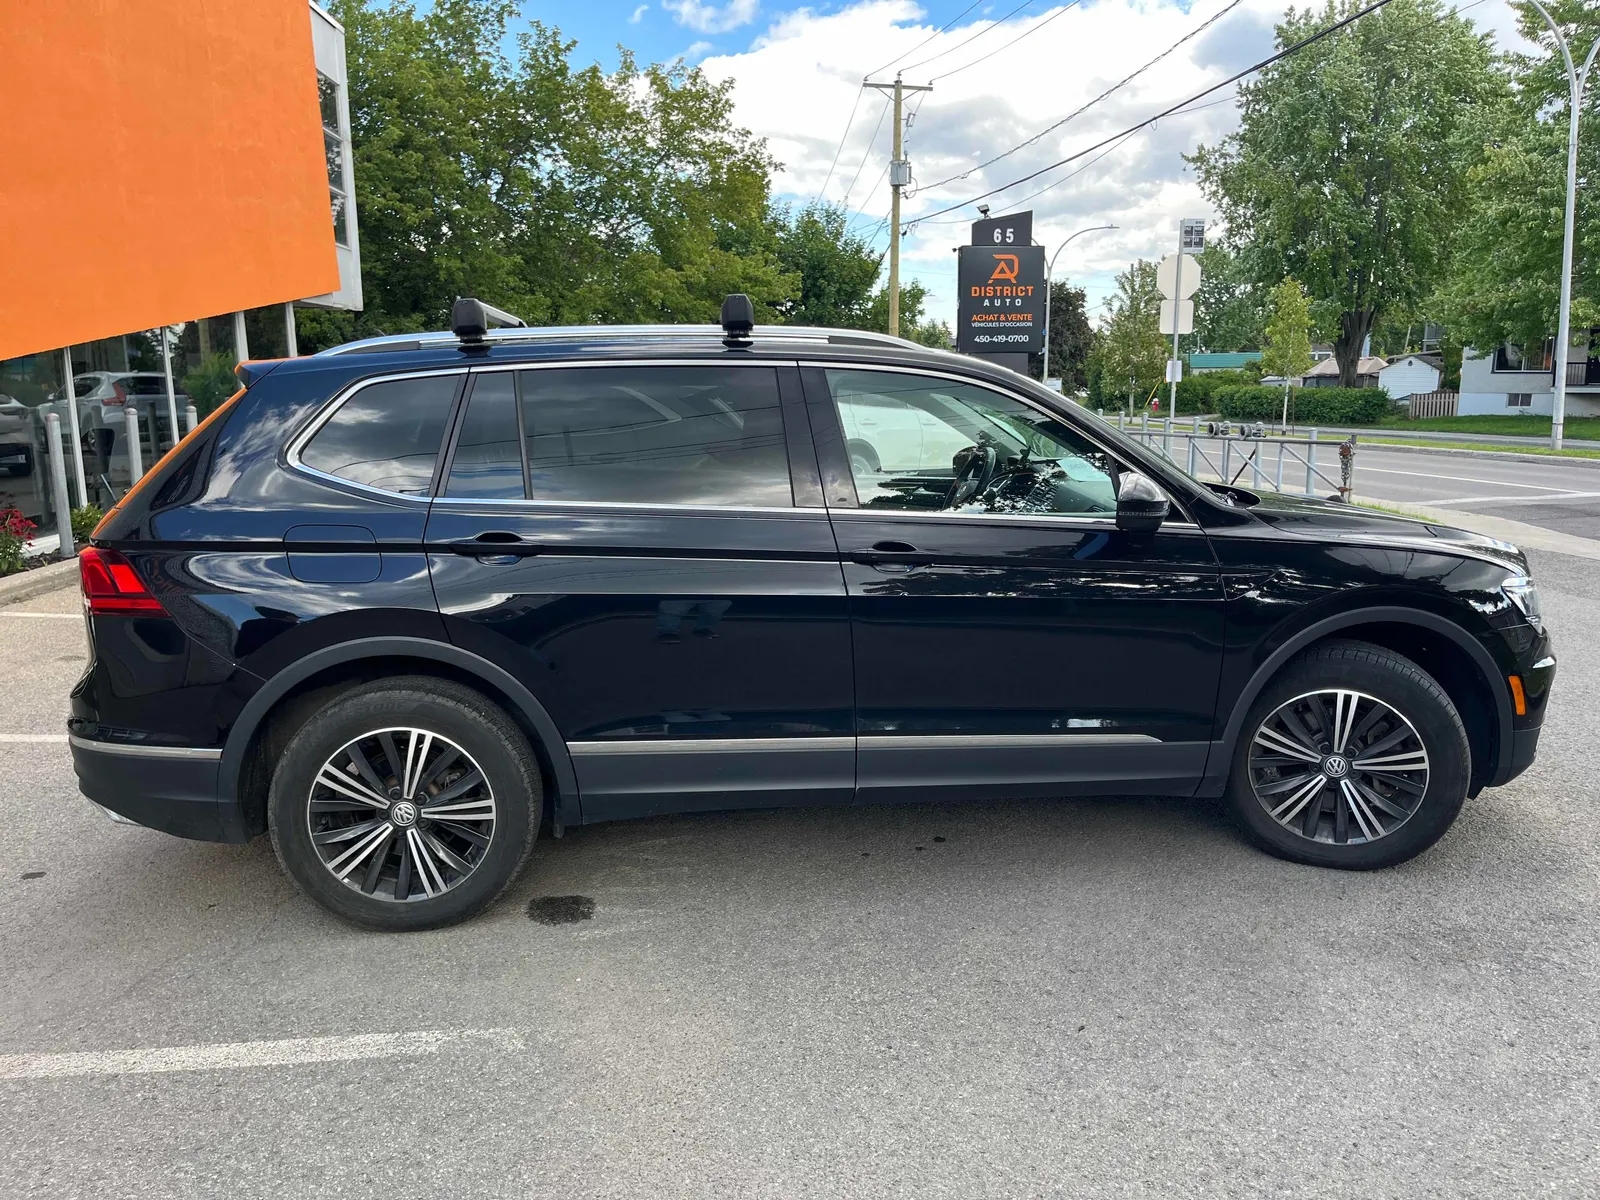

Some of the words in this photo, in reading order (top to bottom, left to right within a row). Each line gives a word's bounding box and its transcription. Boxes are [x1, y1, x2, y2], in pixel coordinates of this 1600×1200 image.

[993, 228, 1014, 243] 65
[971, 286, 1034, 297] DISTRICT
[983, 298, 1022, 307] AUTO
[971, 313, 998, 321] ACHAT
[999, 313, 1006, 321] &
[1006, 313, 1033, 321] VENTE
[971, 320, 999, 328] VÉHICULES
[973, 334, 1029, 343] 450-419-0700
